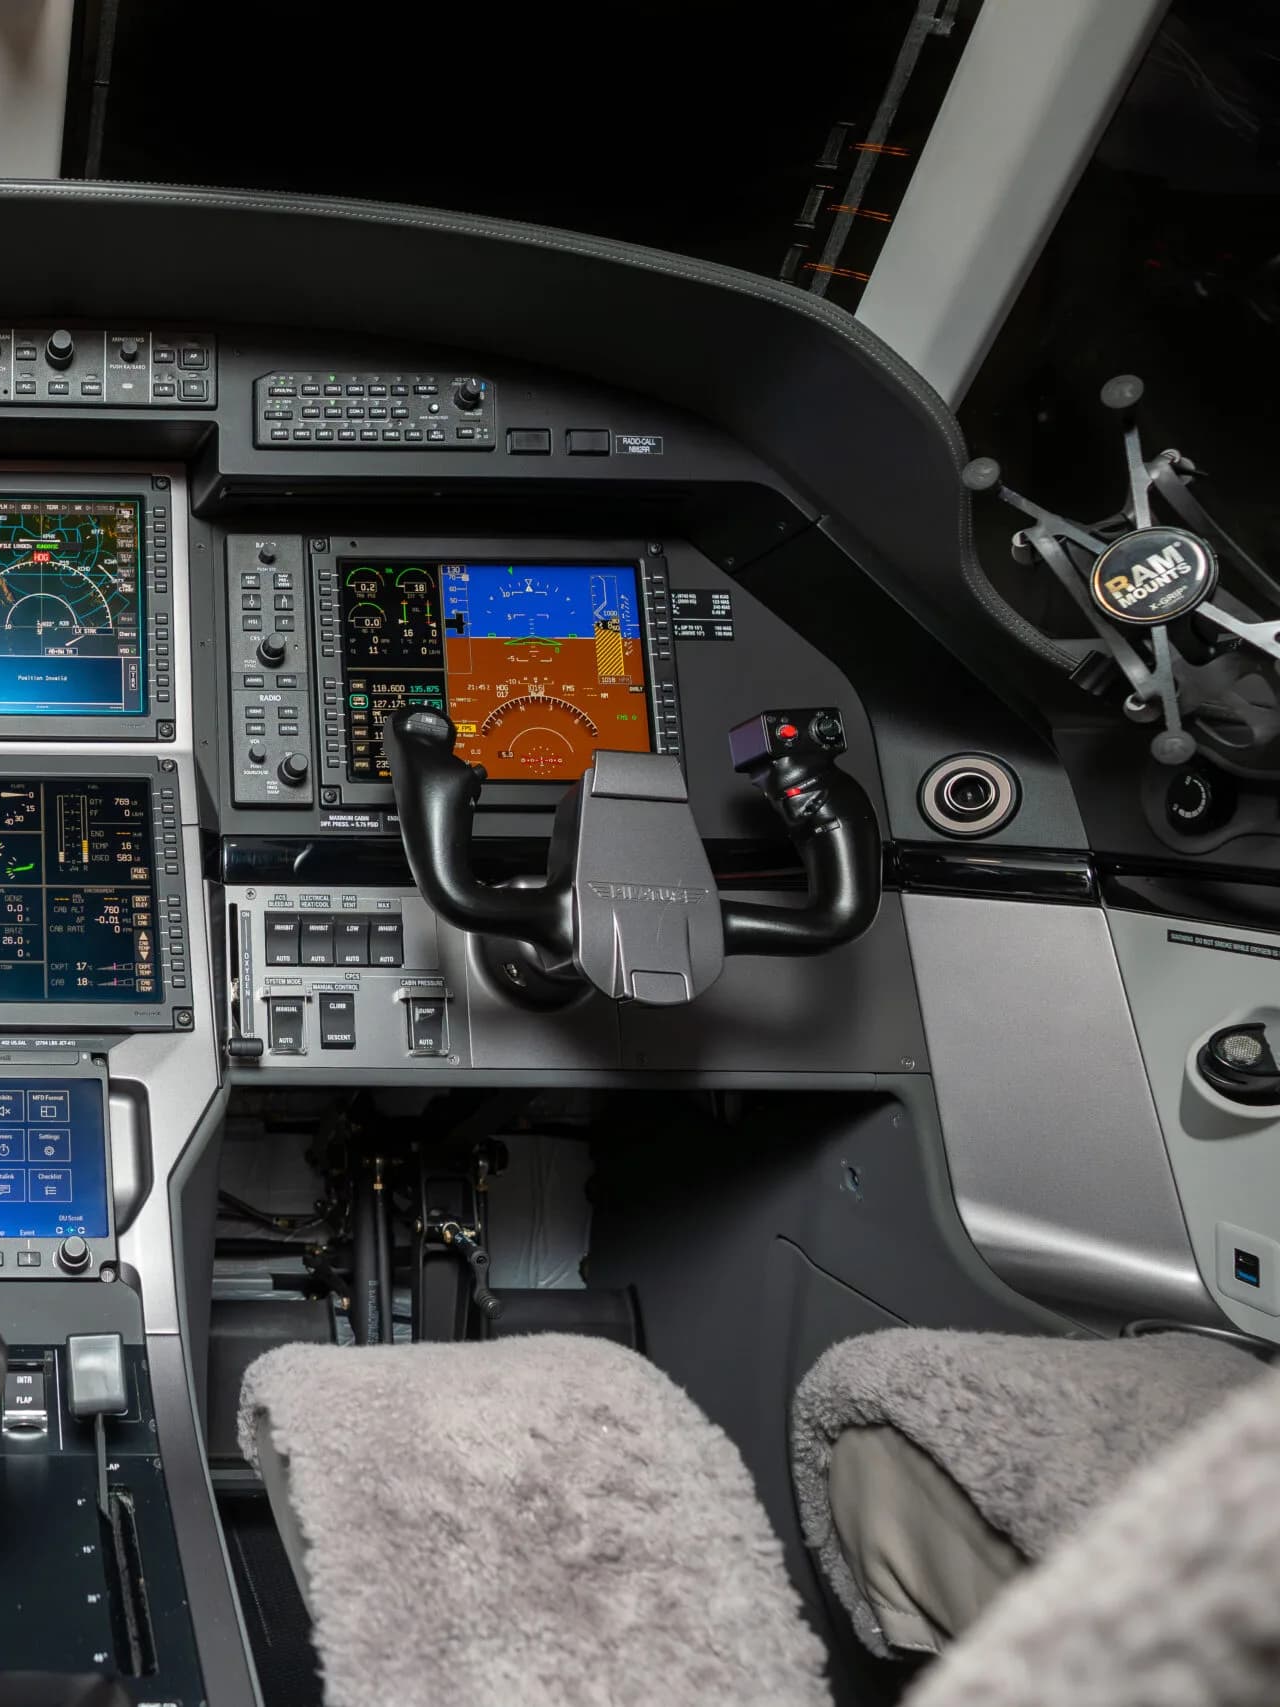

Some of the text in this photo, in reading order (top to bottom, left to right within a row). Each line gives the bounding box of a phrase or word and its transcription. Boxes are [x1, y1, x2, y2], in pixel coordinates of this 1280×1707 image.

[33, 552, 50, 562] HDG
[1104, 545, 1185, 599] RAM
[360, 583, 375, 592] 0.2
[1118, 562, 1192, 608] MOUNTS
[364, 618, 380, 627] 0.0
[403, 628, 414, 637] 16
[368, 646, 378, 654] 11
[259, 694, 282, 702] RADIO
[114, 798, 130, 806] 769
[121, 842, 132, 850] 16
[116, 854, 132, 862] 583
[7, 904, 23, 912] 0.0
[114, 925, 120, 934] 0
[2, 936, 24, 945] 26.0
[76, 962, 88, 971] 17
[243, 953, 251, 996] OXYGEN
[77, 977, 88, 986] 18
[401, 979, 443, 987] CABIN PRESSURE
[419, 1038, 434, 1046] AUTO
[16, 1376, 33, 1384] INTR
[16, 1396, 33, 1404] FLAP
[83, 1545, 95, 1554] 15°
